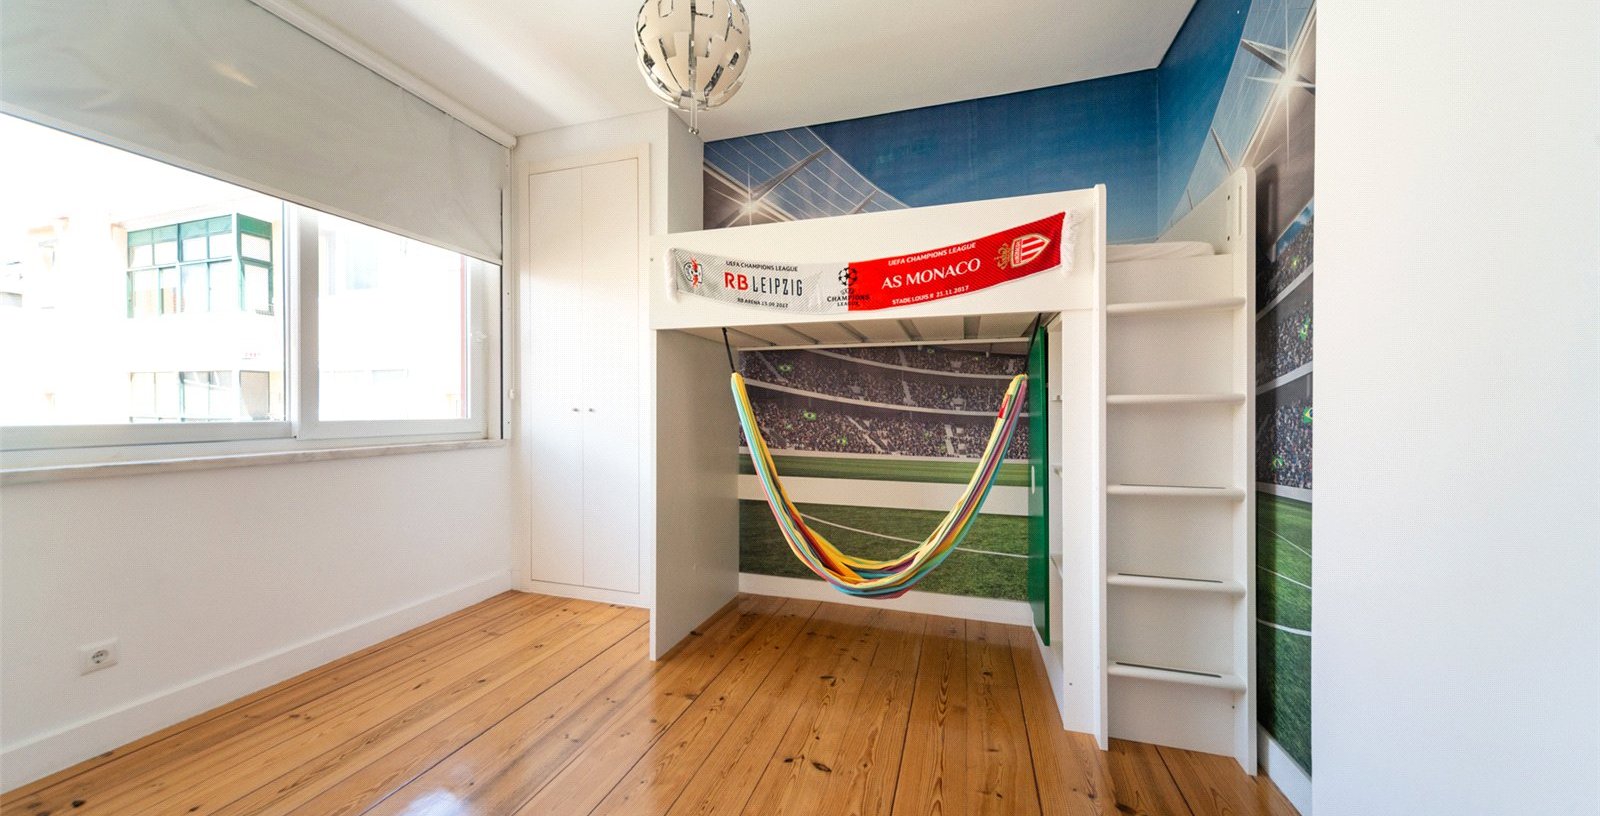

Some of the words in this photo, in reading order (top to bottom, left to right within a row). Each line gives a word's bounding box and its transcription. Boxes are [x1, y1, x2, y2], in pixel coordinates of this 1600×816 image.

[887, 259, 906, 267] UEFA
[906, 249, 948, 264] CHAMPIONS
[948, 242, 976, 254] LEAGUE
[740, 262, 774, 271] CHAMPIONS
[881, 275, 902, 290] AS
[906, 257, 981, 286] MONACO
[724, 272, 749, 290] RB
[752, 276, 803, 297] LEIPZIG
[827, 294, 870, 302] CHAMPIONS
[892, 297, 911, 306] STADE
[911, 293, 929, 303] LOUIS
